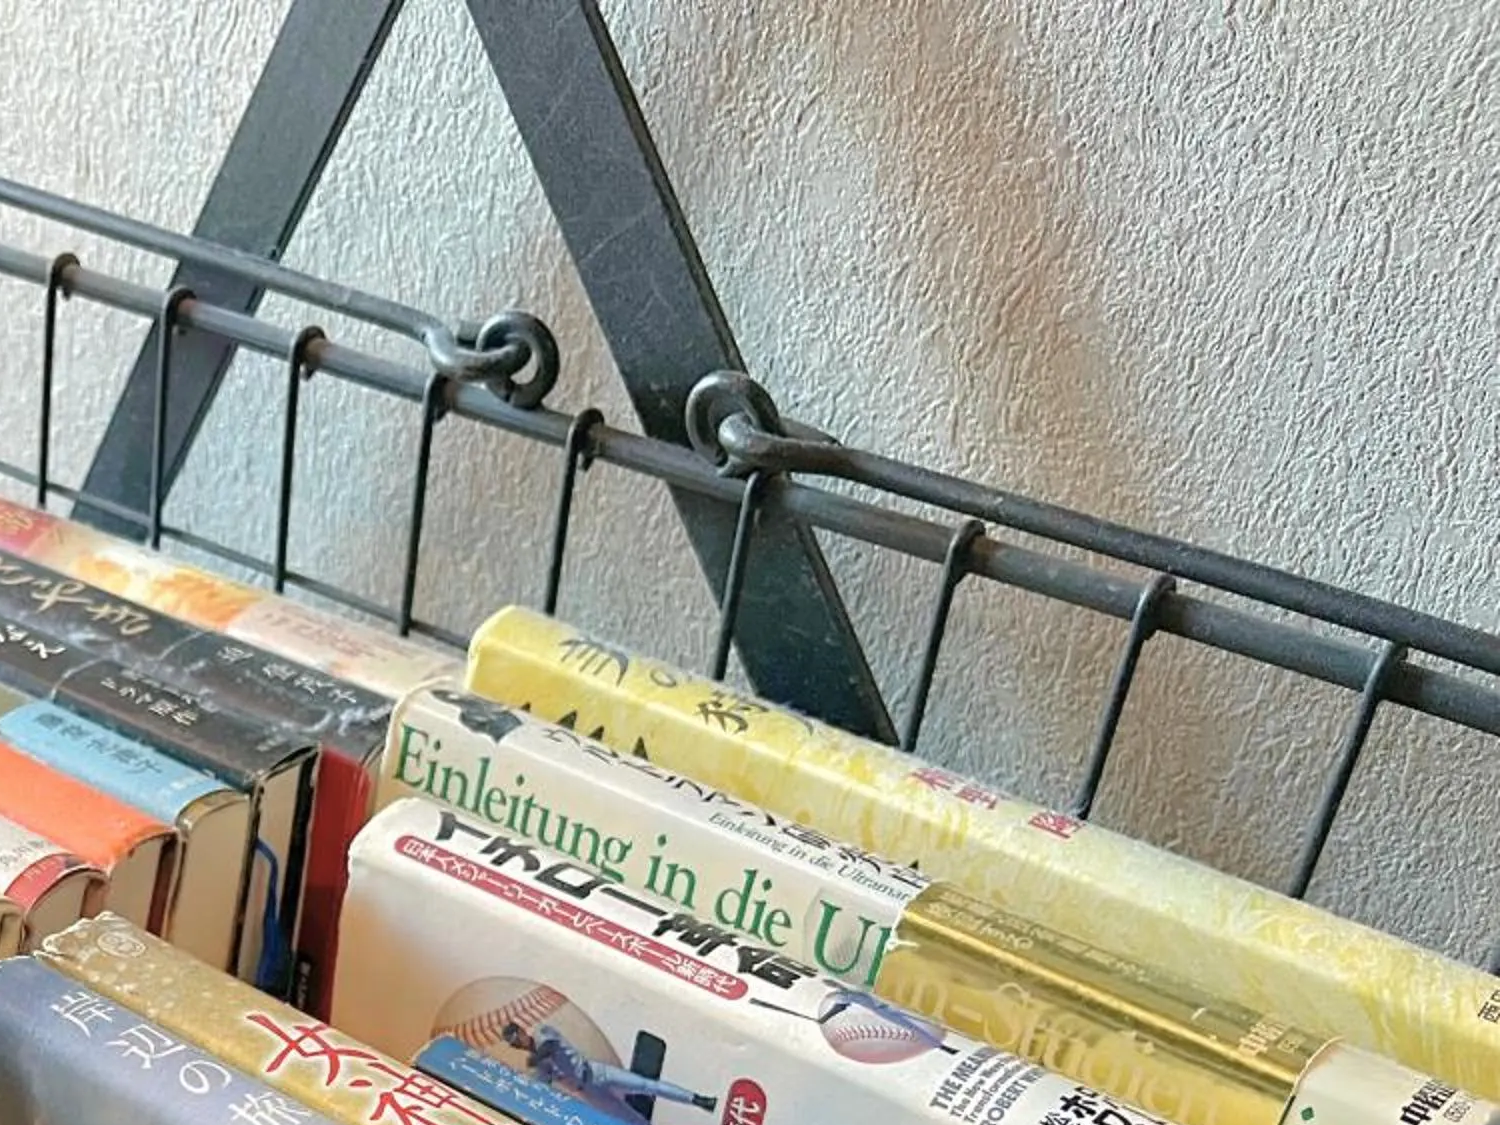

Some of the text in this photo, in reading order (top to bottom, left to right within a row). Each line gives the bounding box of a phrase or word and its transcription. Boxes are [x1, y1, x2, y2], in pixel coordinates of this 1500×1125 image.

[392, 722, 635, 868] Einleitung
[645, 834, 697, 908] in
[714, 869, 794, 948] die
